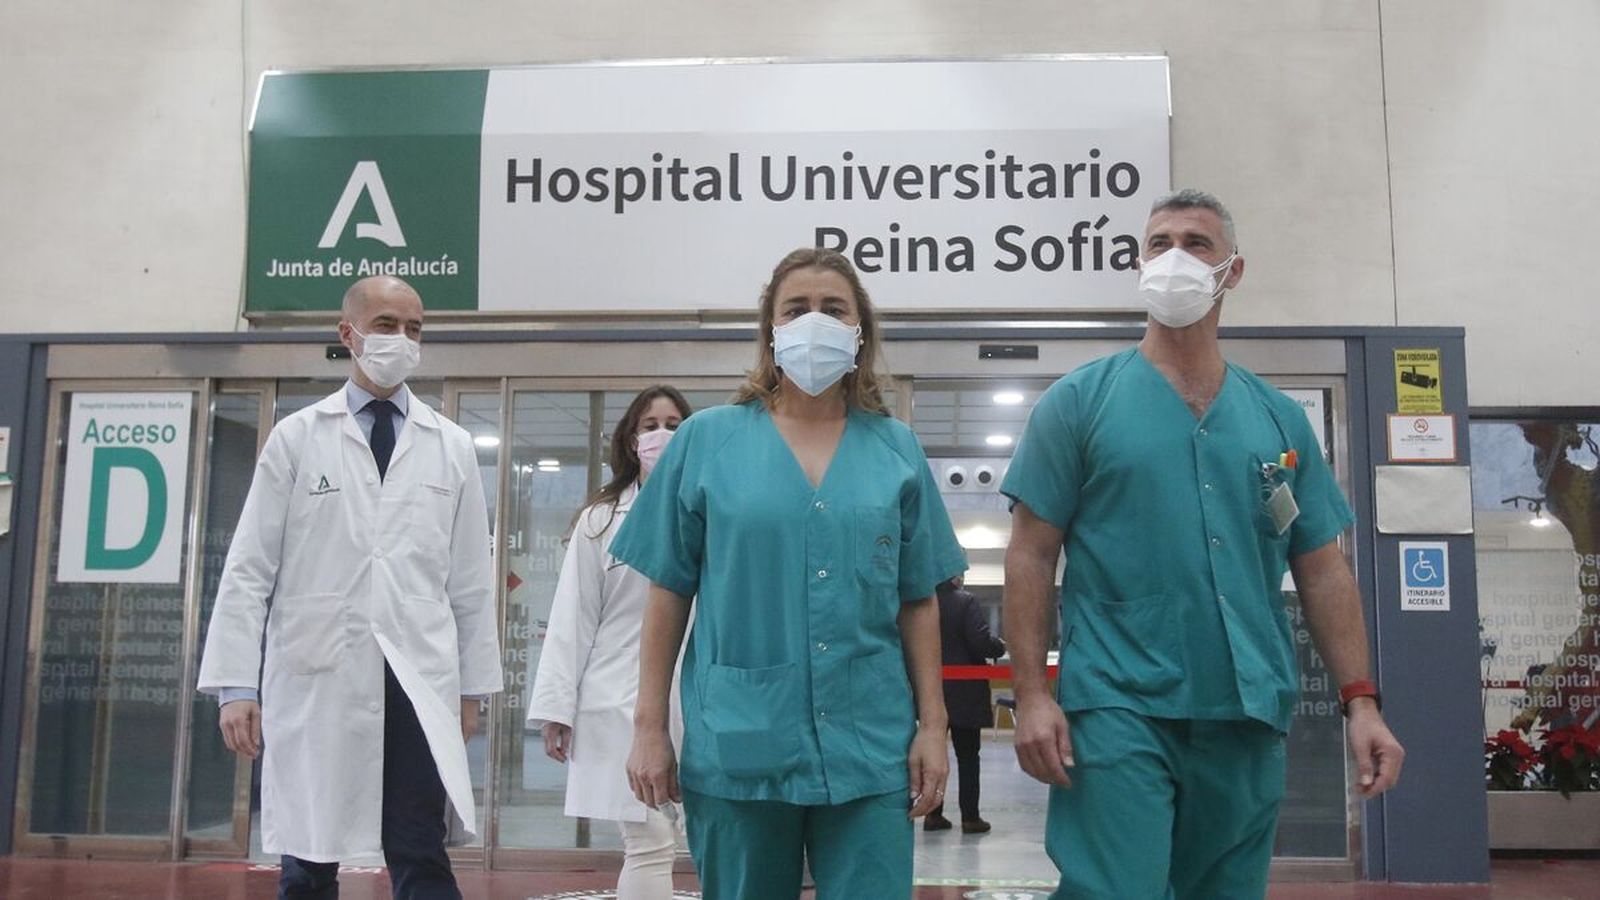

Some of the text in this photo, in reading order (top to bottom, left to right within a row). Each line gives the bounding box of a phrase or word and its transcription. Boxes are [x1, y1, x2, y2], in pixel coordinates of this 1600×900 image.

[506, 148, 1140, 214] Hospital Universitario
[266, 254, 459, 277] Junta de Andalucía
[993, 214, 1140, 272] Sofía
[82, 418, 177, 444] Acceso
[84, 446, 168, 570] D
